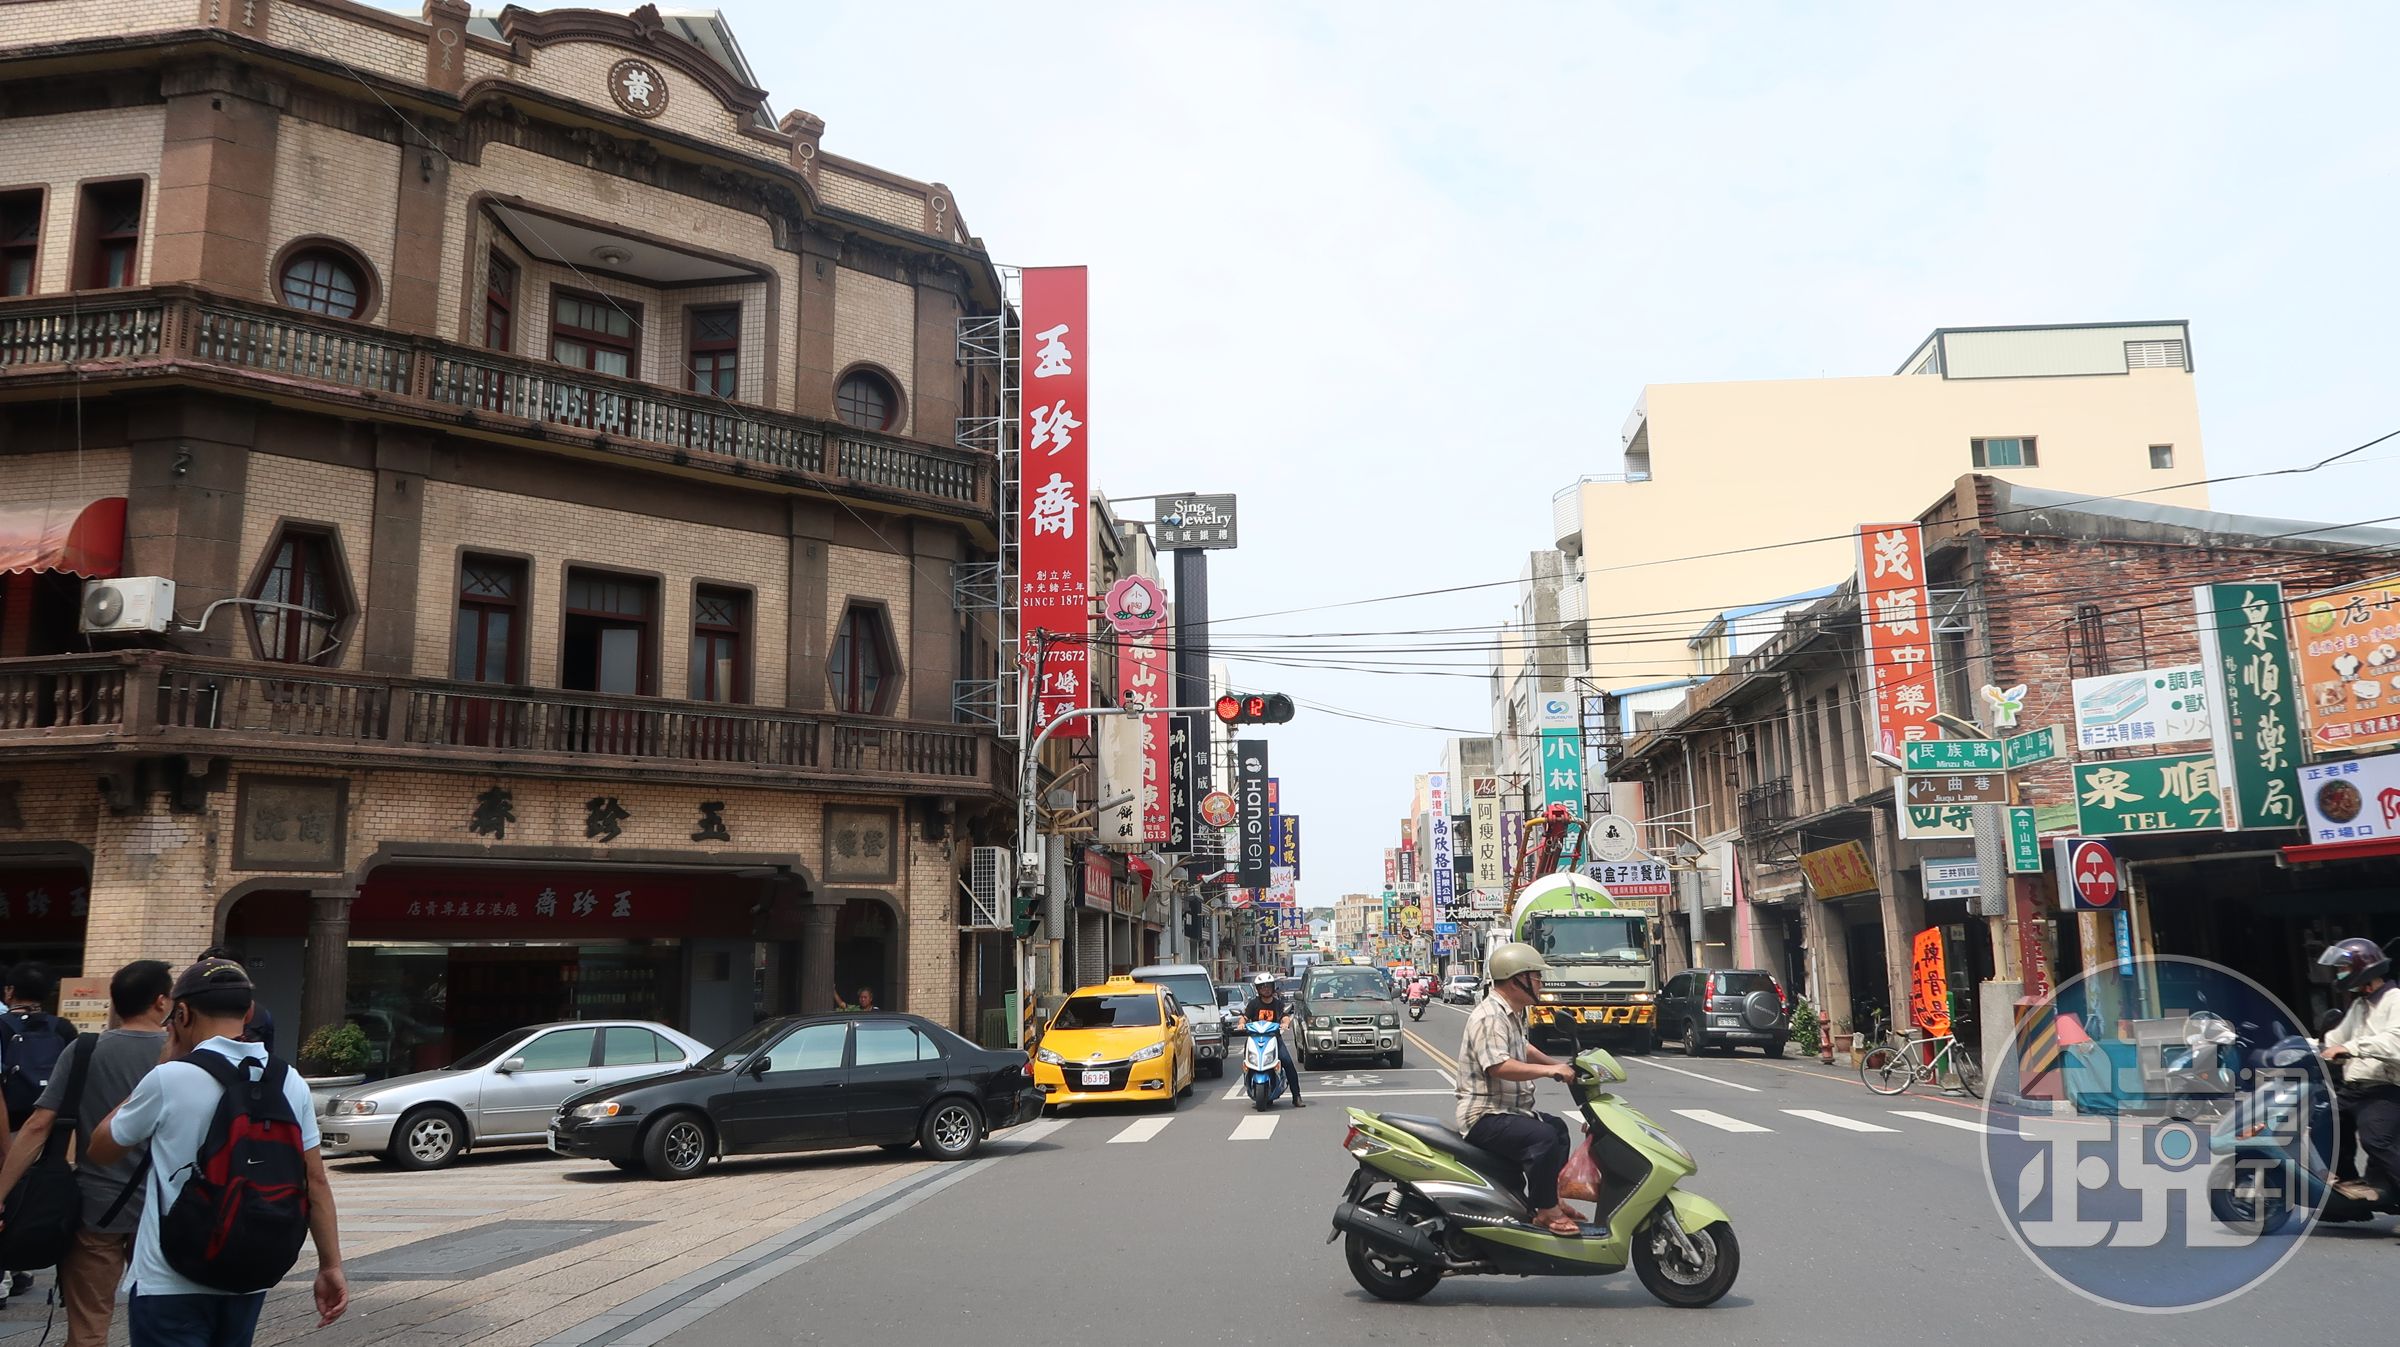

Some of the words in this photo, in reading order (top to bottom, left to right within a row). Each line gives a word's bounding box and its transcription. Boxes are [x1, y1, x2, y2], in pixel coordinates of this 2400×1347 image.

[1174, 500, 1206, 516] Sing
[1179, 510, 1232, 528] Jewelry
[1036, 570, 1072, 581] 創立於
[1023, 597, 1055, 607] SINCE
[1060, 595, 1085, 606] 1877
[1920, 743, 1989, 758] 民族路
[1936, 760, 1960, 768] Minzu
[1963, 760, 1977, 768] Rd.
[1920, 776, 1990, 792] 九曲巷
[2118, 811, 2177, 831] TEL
[2190, 808, 2223, 827] 7
[2018, 819, 2032, 856] 中山路
[2319, 824, 2373, 840] 市場口
[1433, 819, 1450, 868] 尚欣格
[1478, 803, 1497, 881] 阿瘦皮鞋
